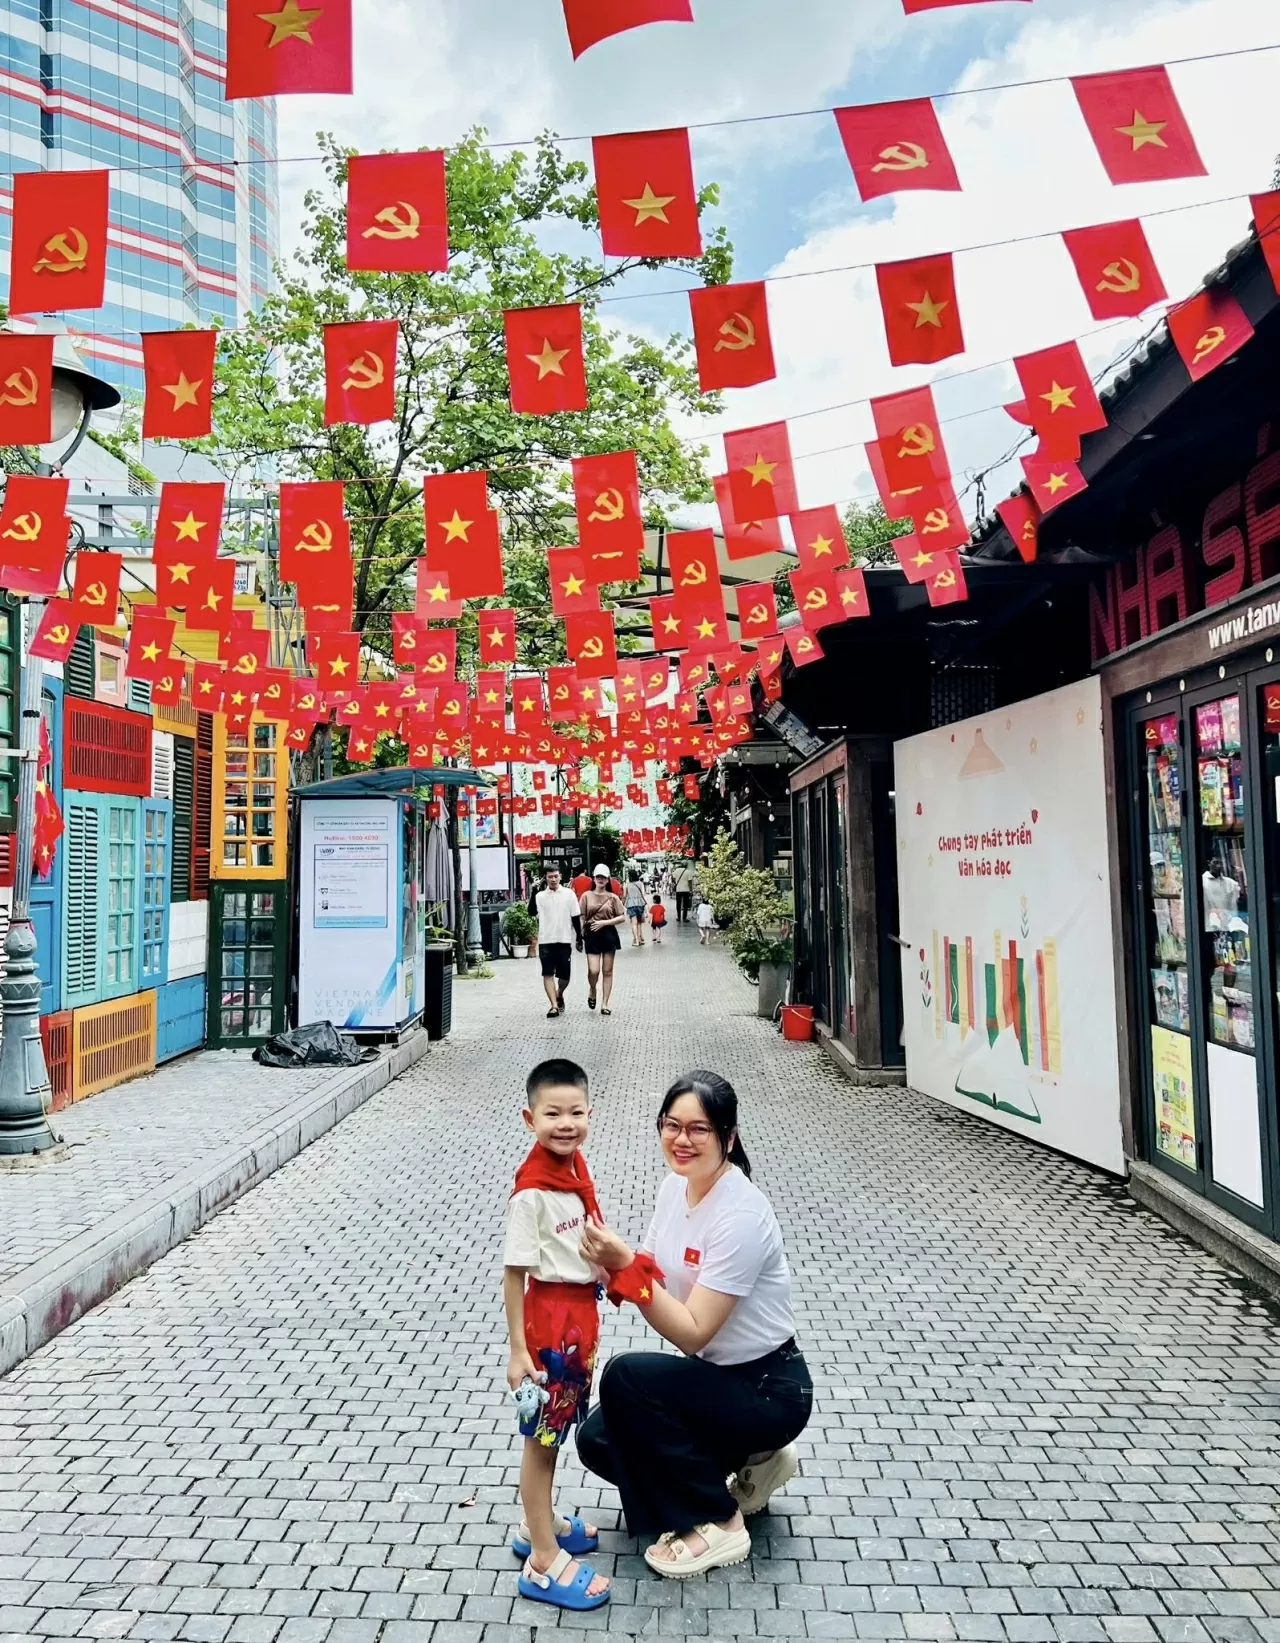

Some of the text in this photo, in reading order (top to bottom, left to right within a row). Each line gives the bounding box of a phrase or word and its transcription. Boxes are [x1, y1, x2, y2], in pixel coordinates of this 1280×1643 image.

[938, 821, 1032, 852] Chung tay phát triển
[976, 857, 992, 876] hóa
[994, 858, 1011, 879] đọc
